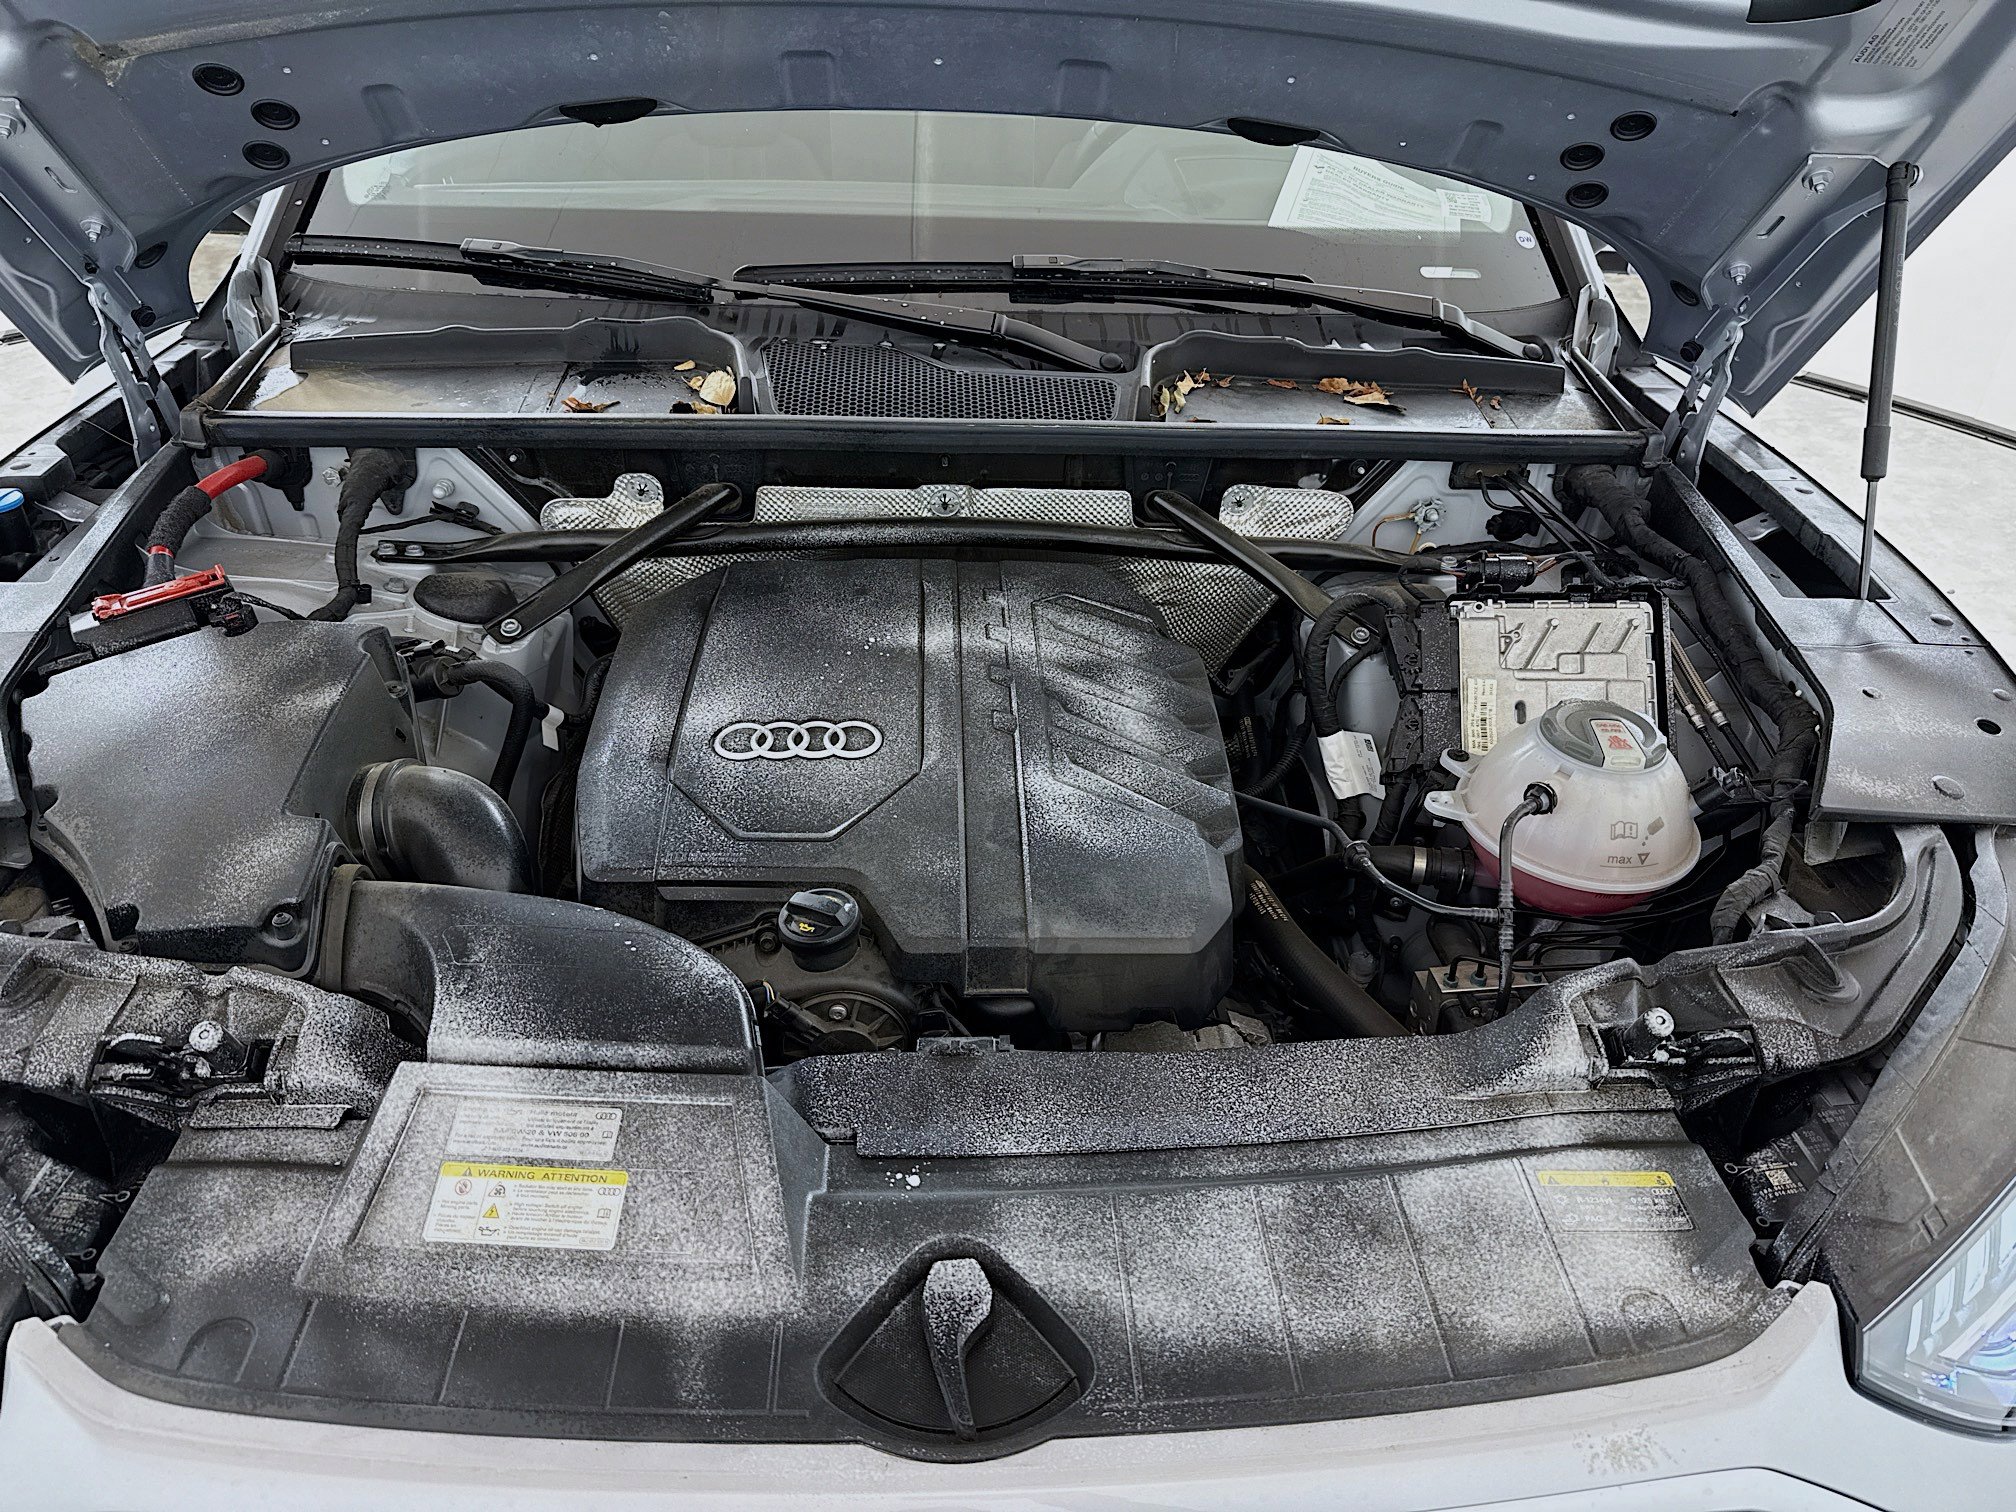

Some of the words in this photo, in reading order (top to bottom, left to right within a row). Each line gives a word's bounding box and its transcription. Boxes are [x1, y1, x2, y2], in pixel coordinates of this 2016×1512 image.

[1854, 46, 1870, 62] AUDI
[1607, 855, 1632, 864] max
[478, 1169, 535, 1180] WARNING
[542, 1172, 608, 1184] ATTENTION
